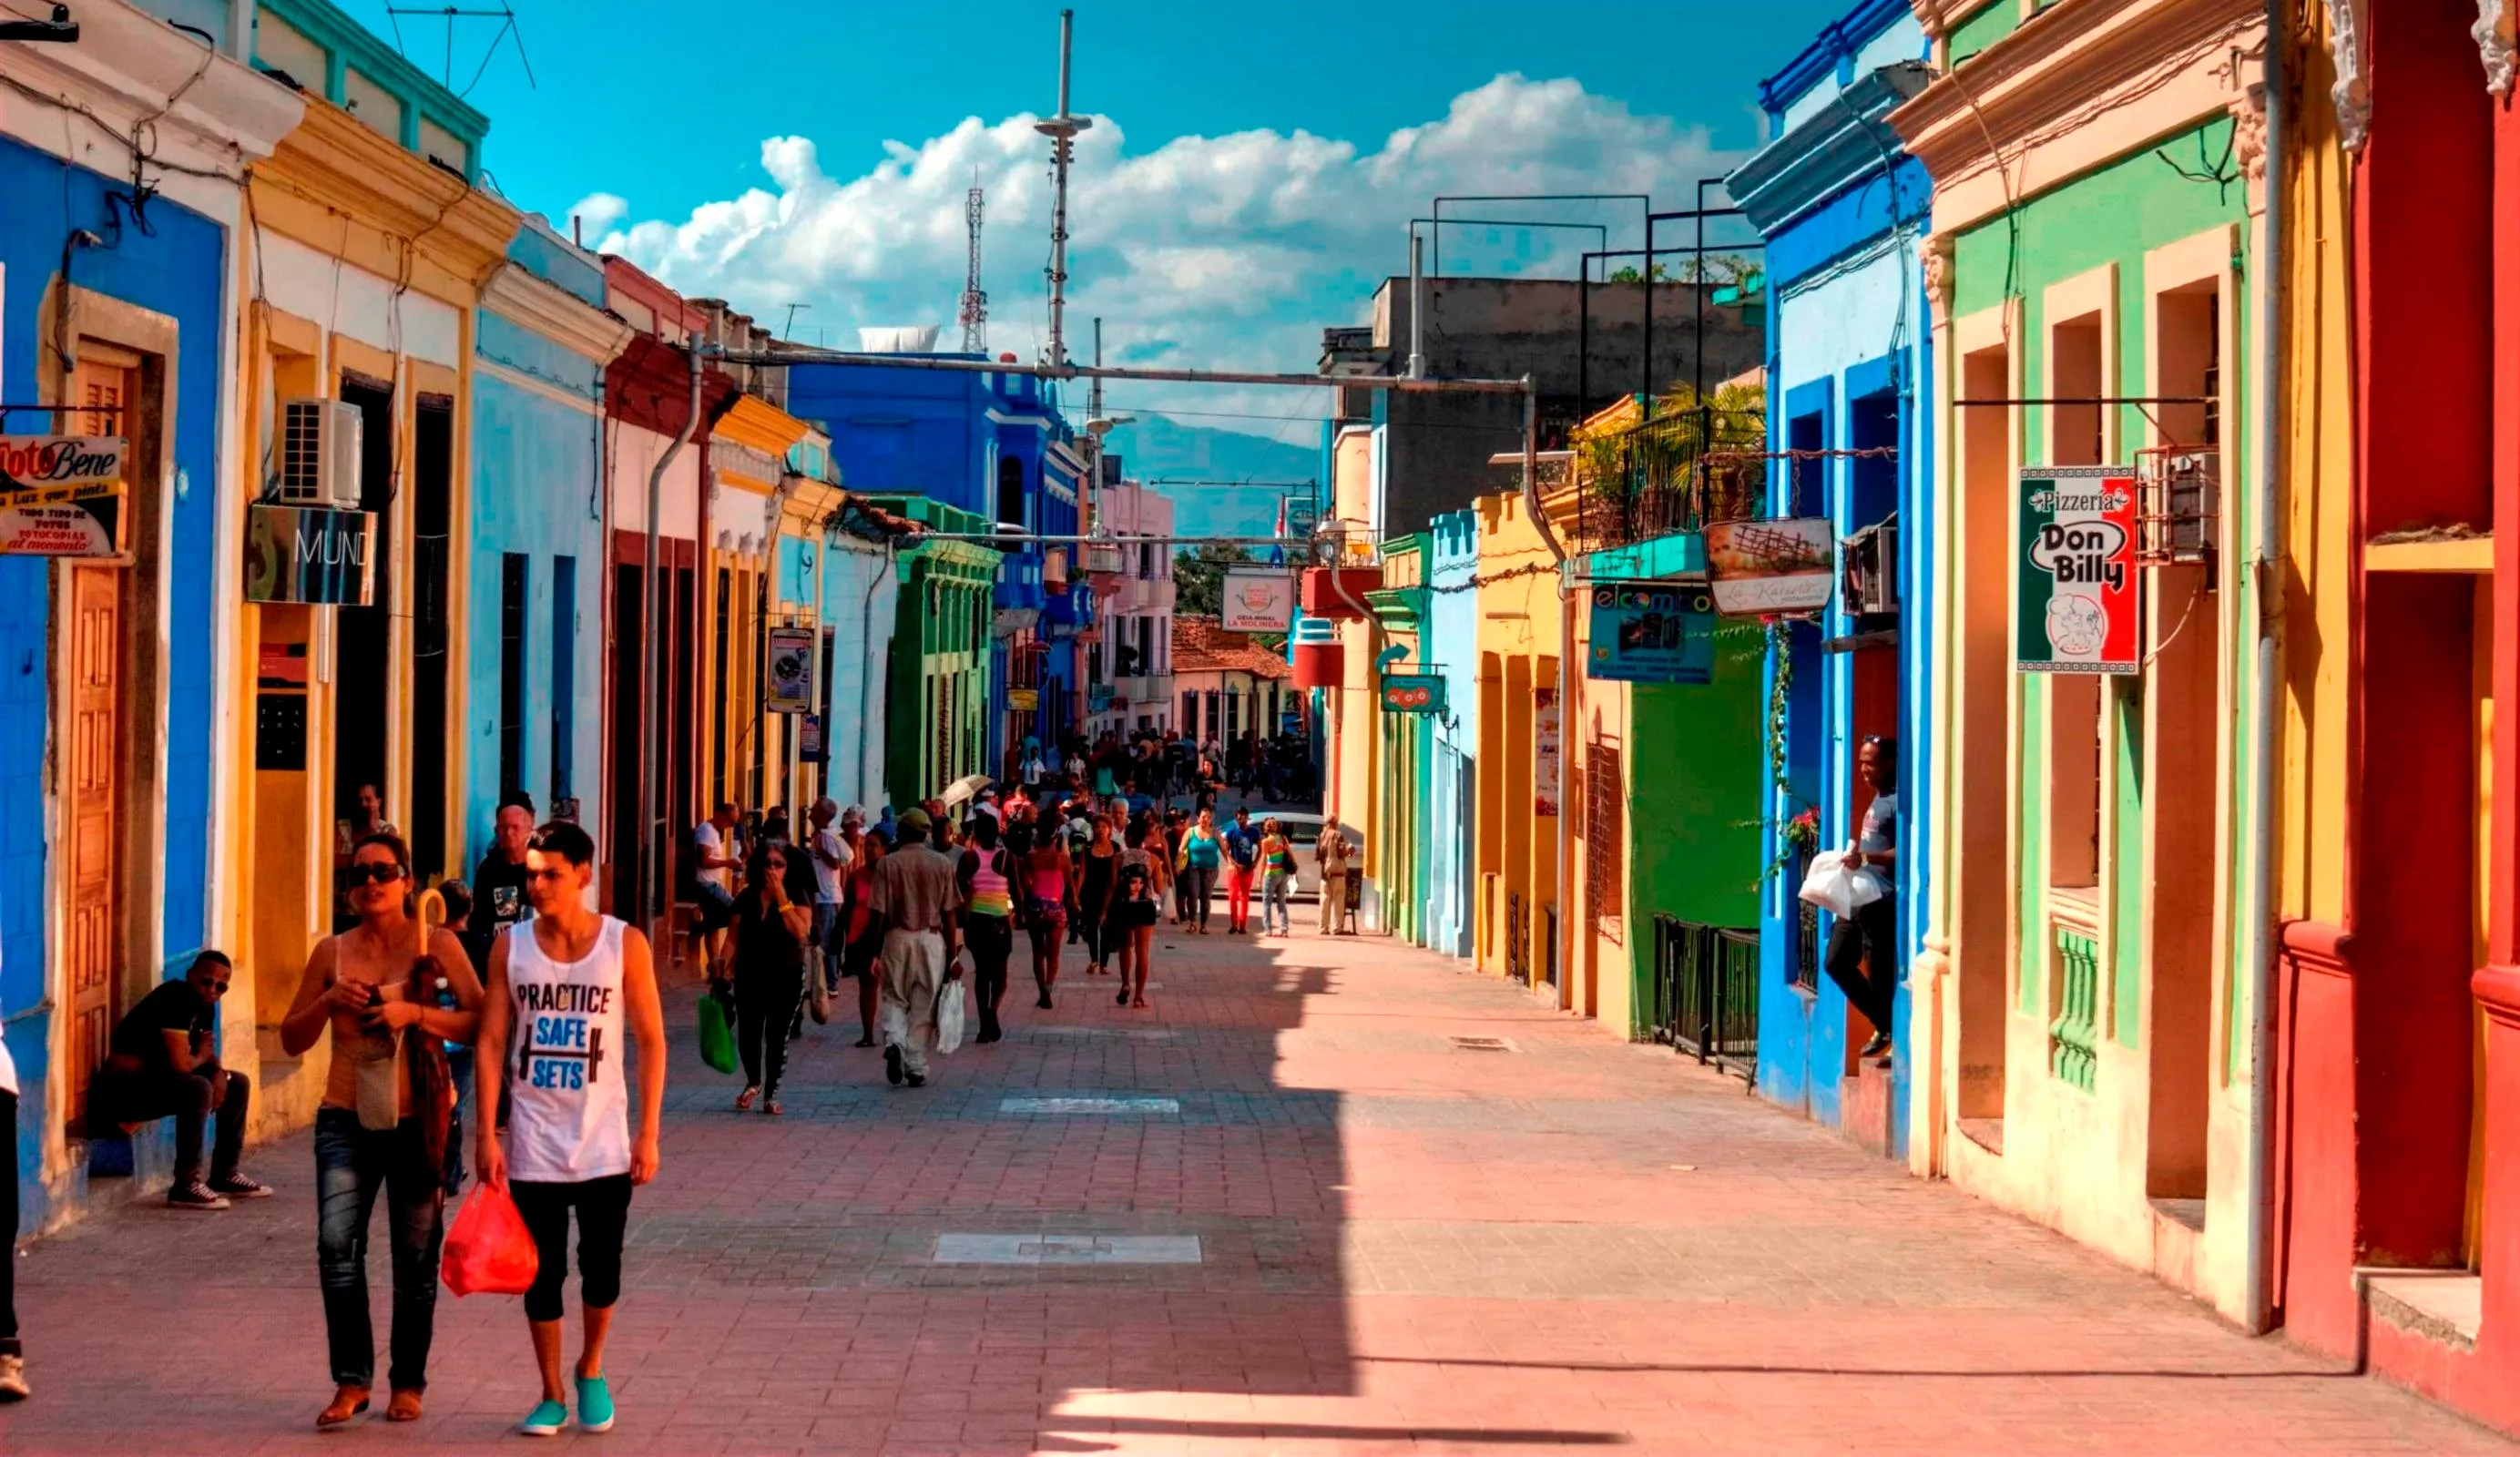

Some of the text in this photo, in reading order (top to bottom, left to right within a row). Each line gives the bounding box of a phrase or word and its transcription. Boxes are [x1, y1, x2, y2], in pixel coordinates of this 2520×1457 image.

[33, 441, 117, 480] Bene
[44, 490, 68, 502] que
[74, 483, 107, 499] pinta
[2043, 490, 2114, 511] Pizzería
[19, 508, 87, 519] TODO TIPO DE
[2041, 524, 2104, 551] Don
[2053, 554, 2124, 592] Billy
[516, 983, 613, 1014] PRACTICE
[536, 1016, 587, 1048] SAFE
[532, 1059, 584, 1090] SETS
